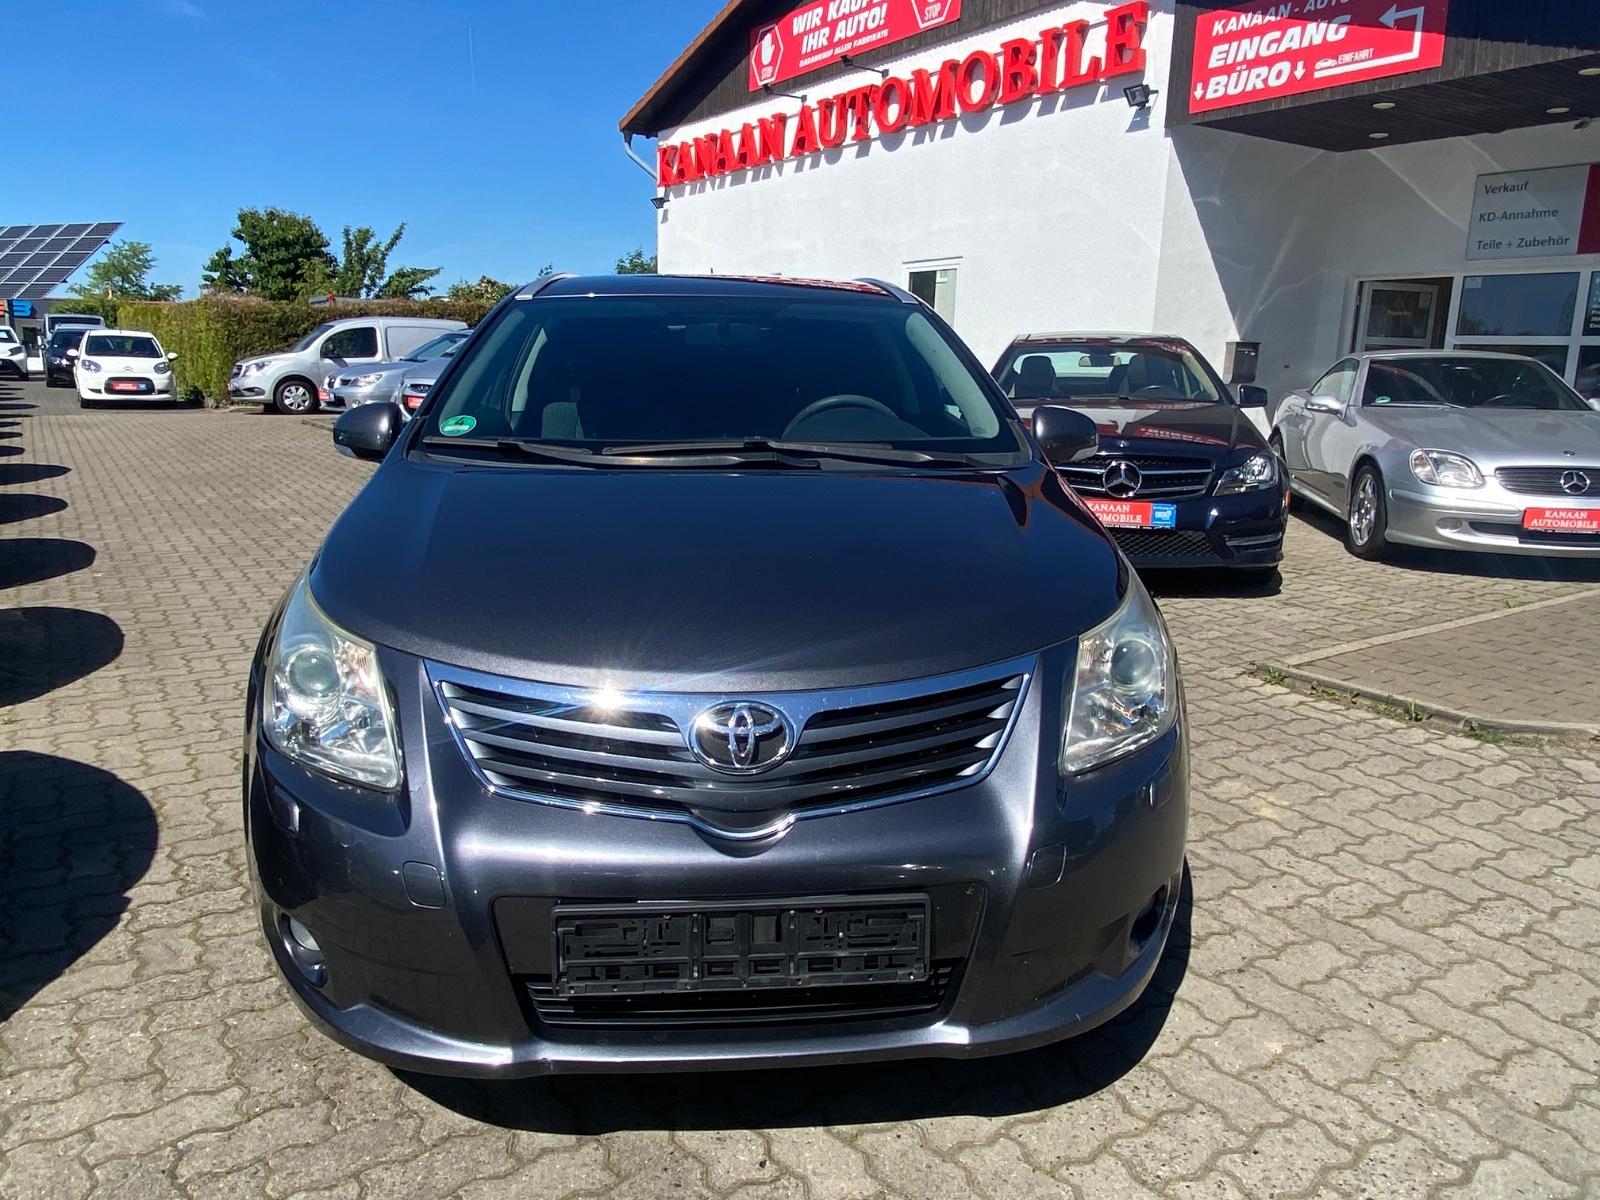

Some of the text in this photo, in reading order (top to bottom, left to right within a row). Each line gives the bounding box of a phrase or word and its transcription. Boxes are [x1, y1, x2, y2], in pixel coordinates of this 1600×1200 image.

[793, 0, 881, 36] WIR KAU
[924, 3, 941, 20] STOP
[1212, 3, 1291, 37] KANAAN
[801, 3, 888, 55] IHR AUTO!
[833, 42, 853, 55] ALLER
[853, 29, 889, 48] FABRIKATE
[1208, 15, 1351, 69] EINGANG
[1337, 48, 1374, 64] EINFAHRT
[1205, 61, 1292, 100] BÜRO
[657, 0, 1149, 187] KANAAN AUTOMOBILE
[1484, 180, 1529, 194] Verkauf
[1479, 208, 1560, 223] KD-Annahme
[1477, 239, 1503, 250] Teile
[1516, 234, 1571, 249] Zubehör
[454, 416, 465, 426] 4
[1545, 510, 1588, 519] KANAAN
[1530, 518, 1599, 529] AUTOMOBILE
